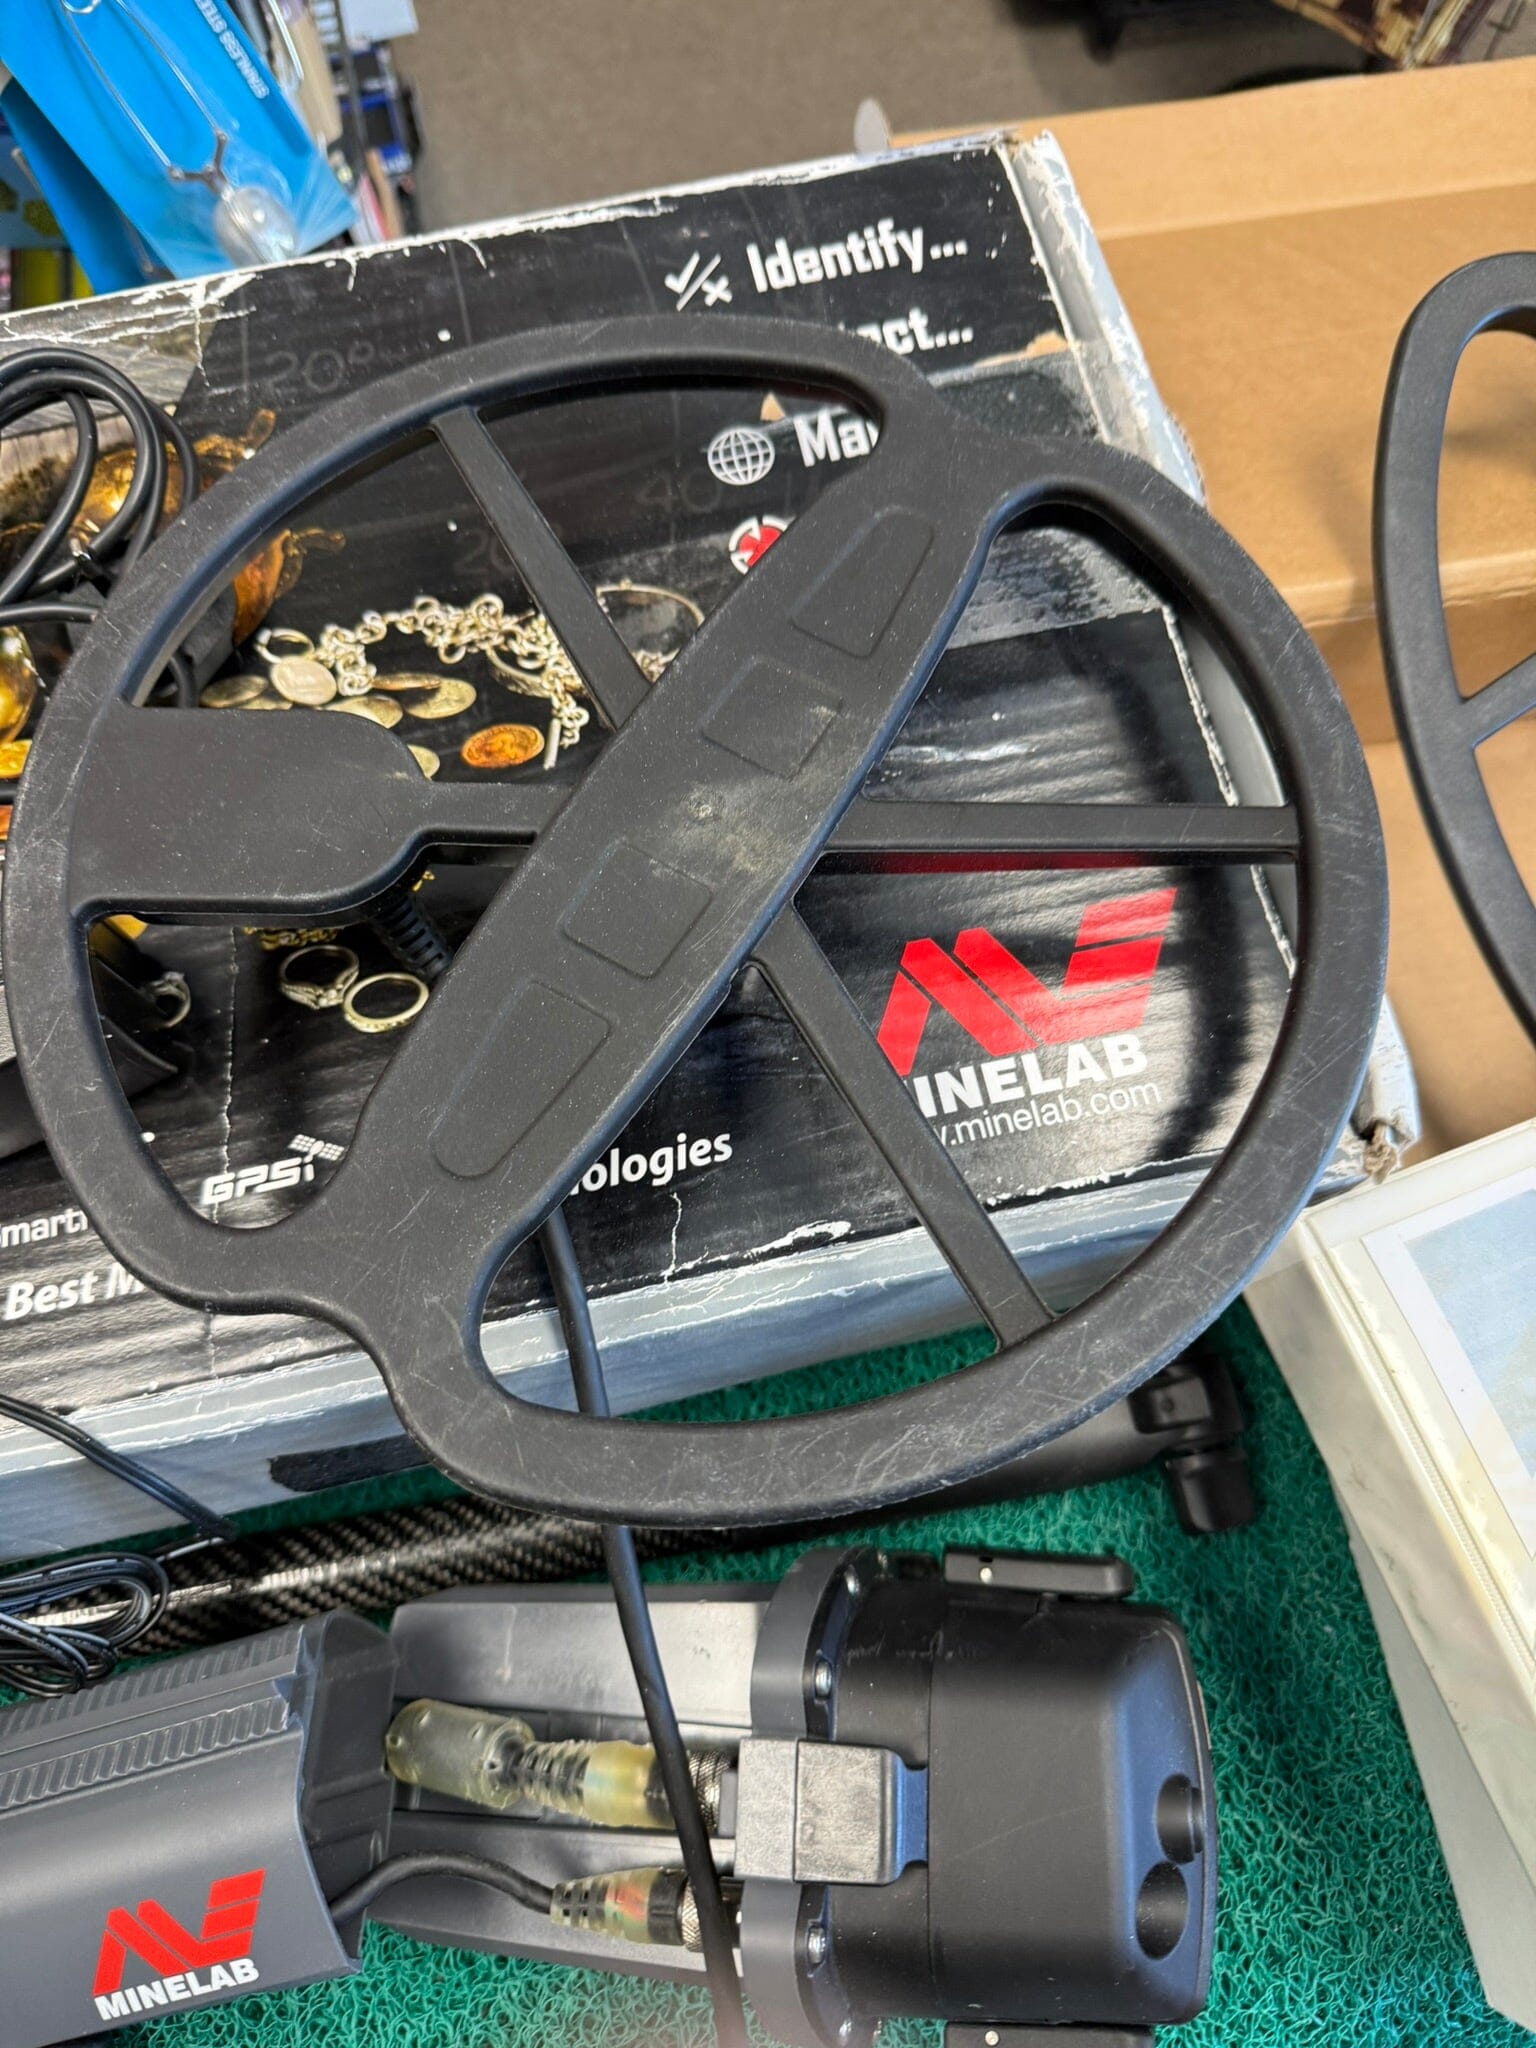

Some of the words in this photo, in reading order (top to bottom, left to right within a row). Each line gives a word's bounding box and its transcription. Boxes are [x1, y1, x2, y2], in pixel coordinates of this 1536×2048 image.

[219, 32, 269, 98] STAINLESS
[746, 218, 968, 293] Identify...
[905, 1033, 1149, 1118] INELAB
[569, 1132, 733, 1196] ologies
[0, 1208, 88, 1248] mart
[2, 1270, 98, 1320] Best
[94, 1958, 260, 2021] MINELAB
